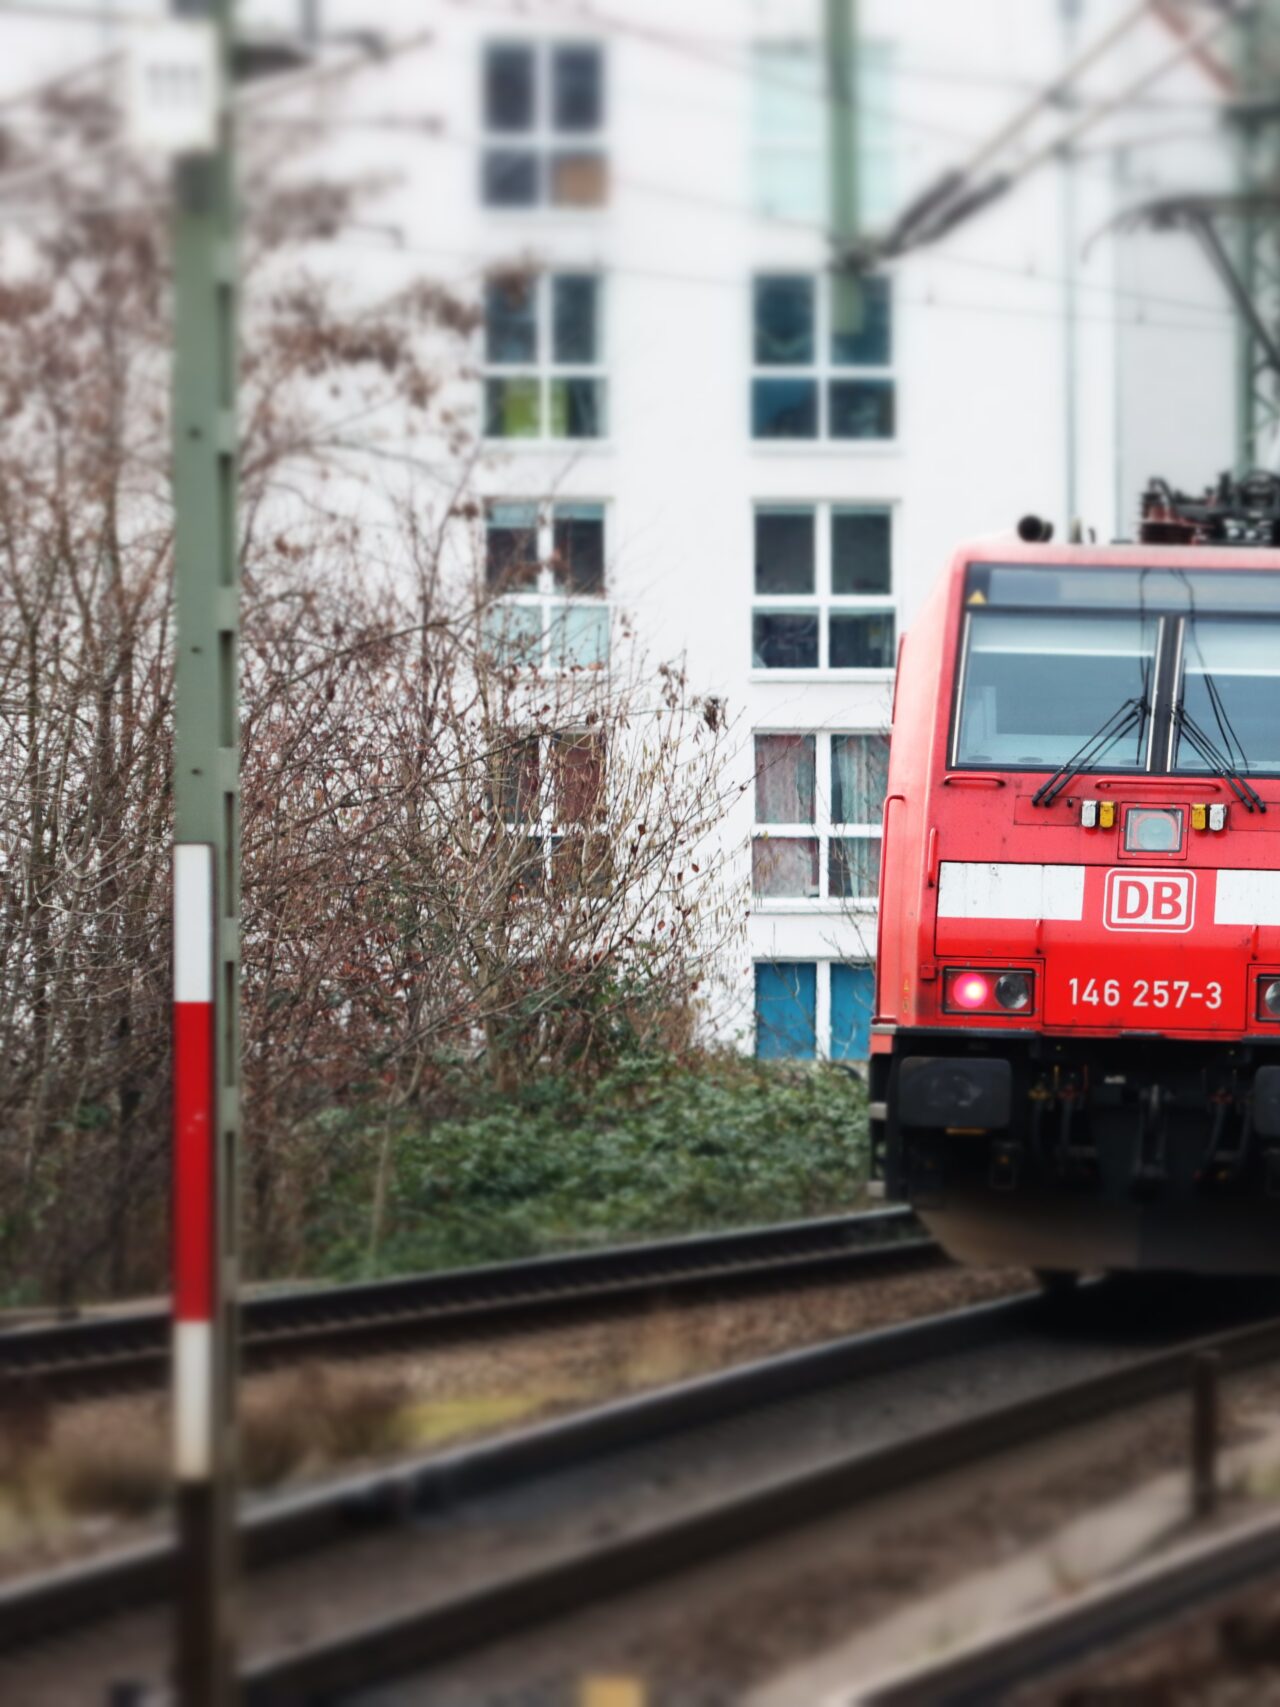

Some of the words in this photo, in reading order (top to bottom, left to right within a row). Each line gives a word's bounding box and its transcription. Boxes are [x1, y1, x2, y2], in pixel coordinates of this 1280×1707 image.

[1115, 878, 1184, 921] DB
[1069, 977, 1121, 1007] 146
[1132, 979, 1223, 1010] 257-3
